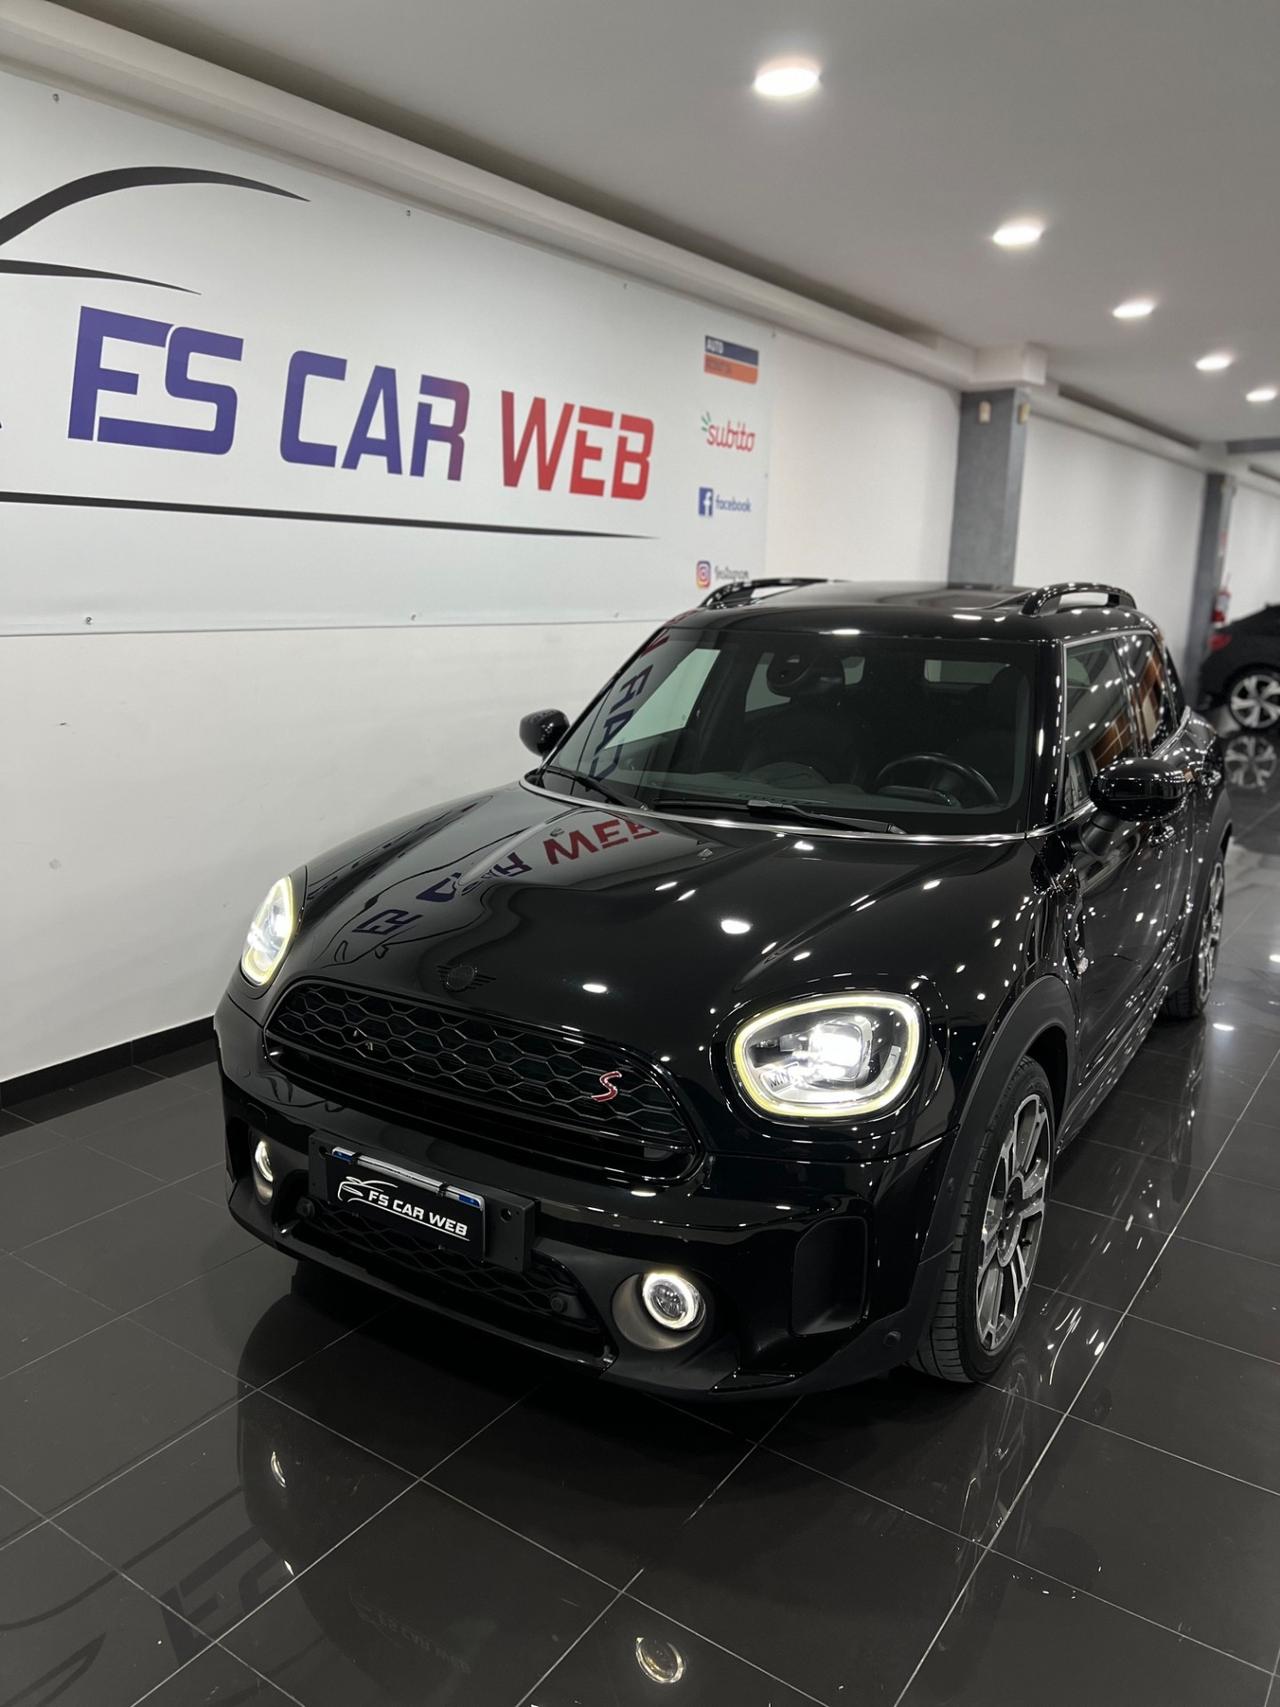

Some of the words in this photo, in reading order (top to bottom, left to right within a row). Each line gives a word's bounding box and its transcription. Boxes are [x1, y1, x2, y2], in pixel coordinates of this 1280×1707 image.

[280, 350, 471, 481] CAR
[501, 390, 655, 501] WEB
[707, 420, 756, 452] subito
[591, 1070, 622, 1102] S
[368, 1190, 389, 1207] FS
[392, 1199, 424, 1220] CAR
[429, 1212, 467, 1236] WEB
